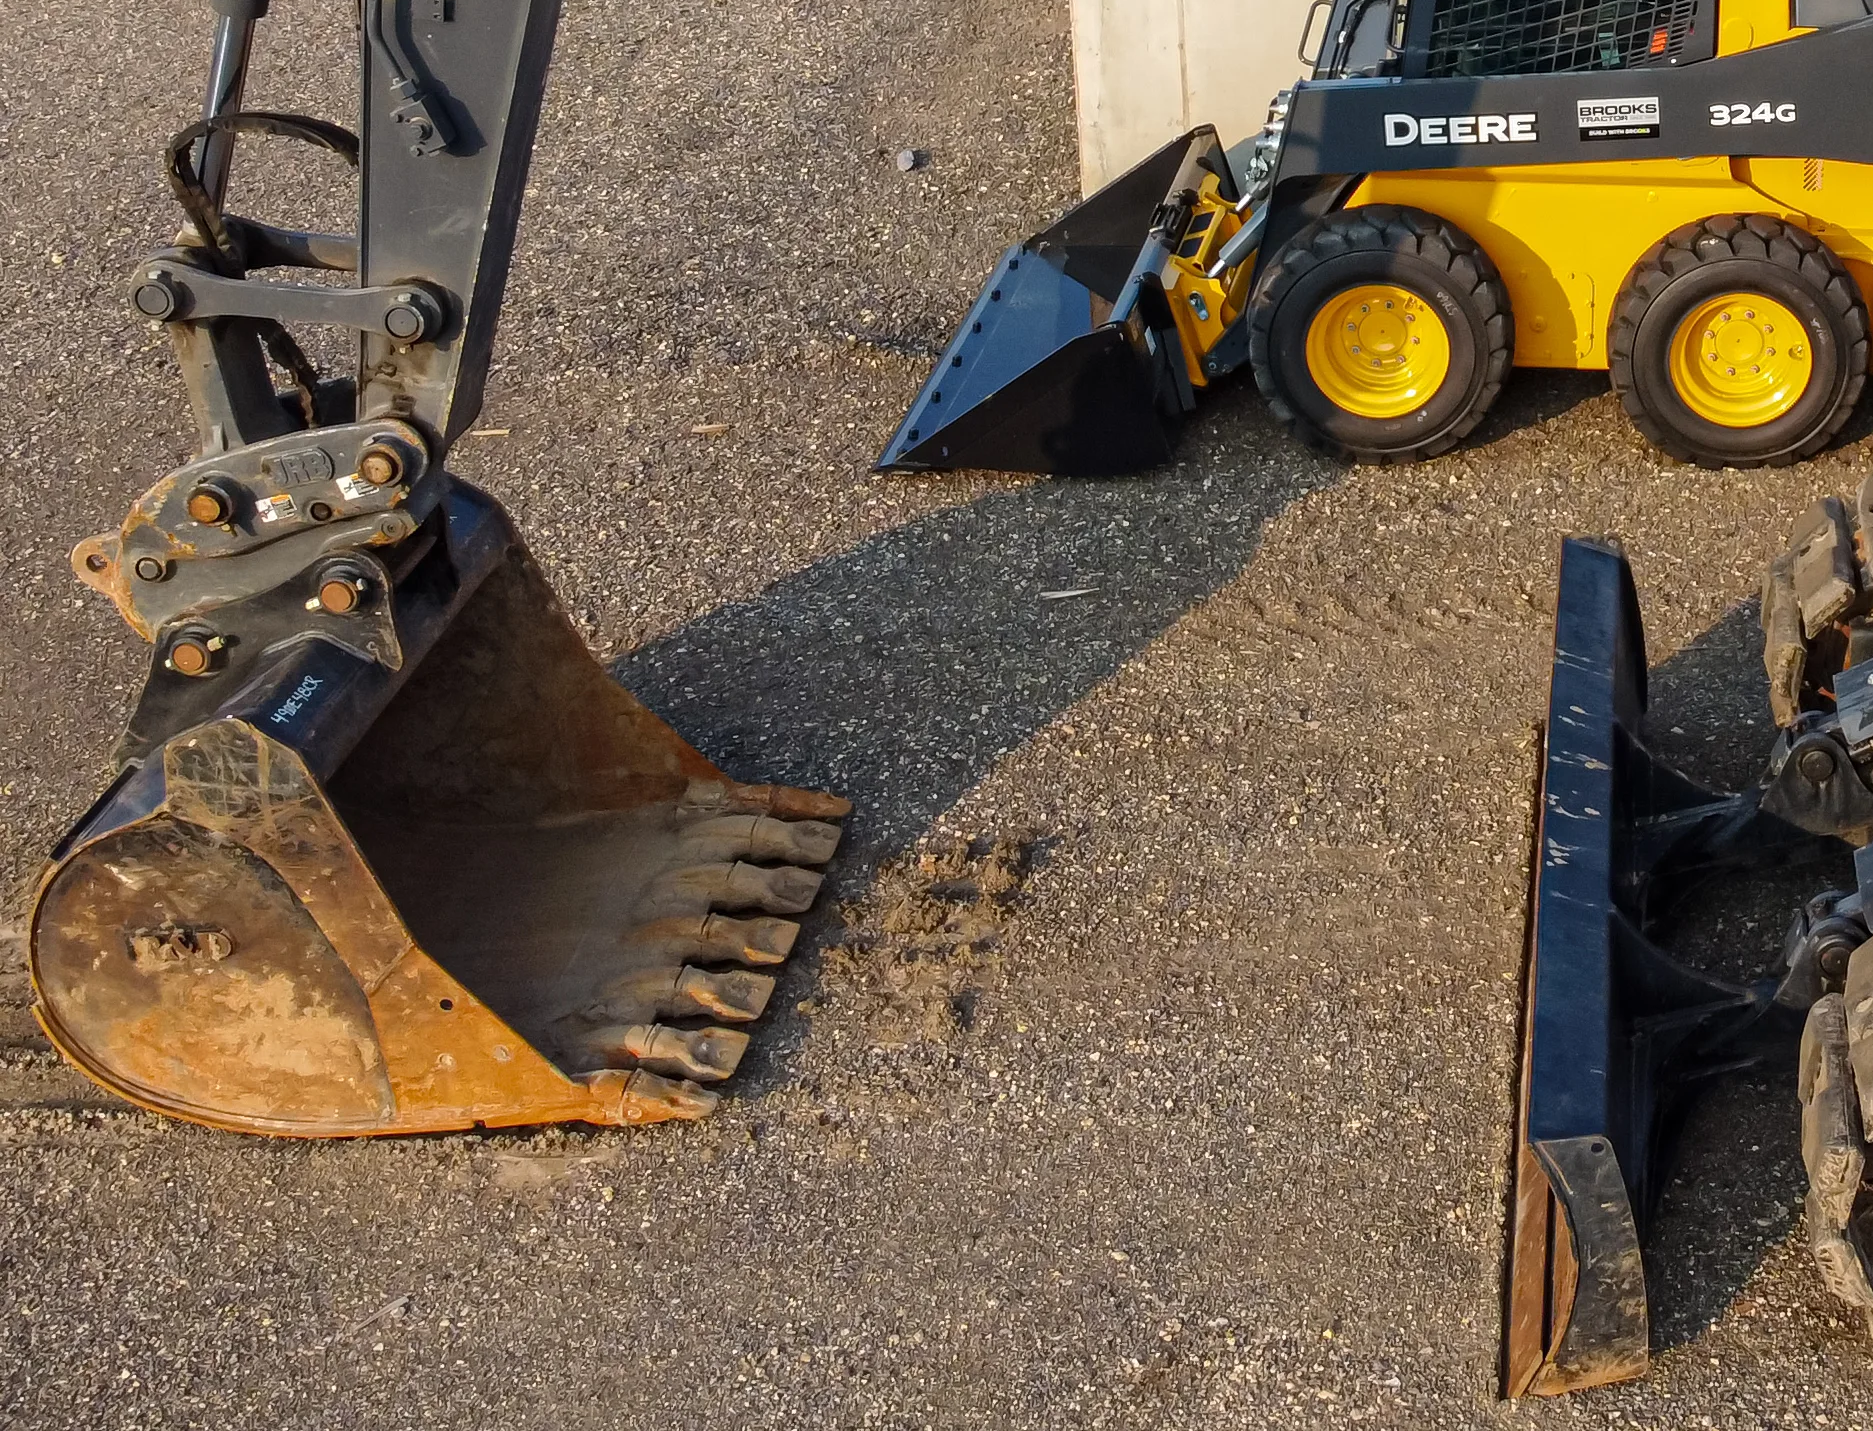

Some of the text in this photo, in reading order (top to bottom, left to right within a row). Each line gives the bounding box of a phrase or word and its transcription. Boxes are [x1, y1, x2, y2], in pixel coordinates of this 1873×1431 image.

[1580, 103, 1657, 117] BROOKS
[1580, 115, 1628, 123] TRACTOR
[1709, 102, 1796, 126] 324G
[1384, 114, 1538, 146] DEERE
